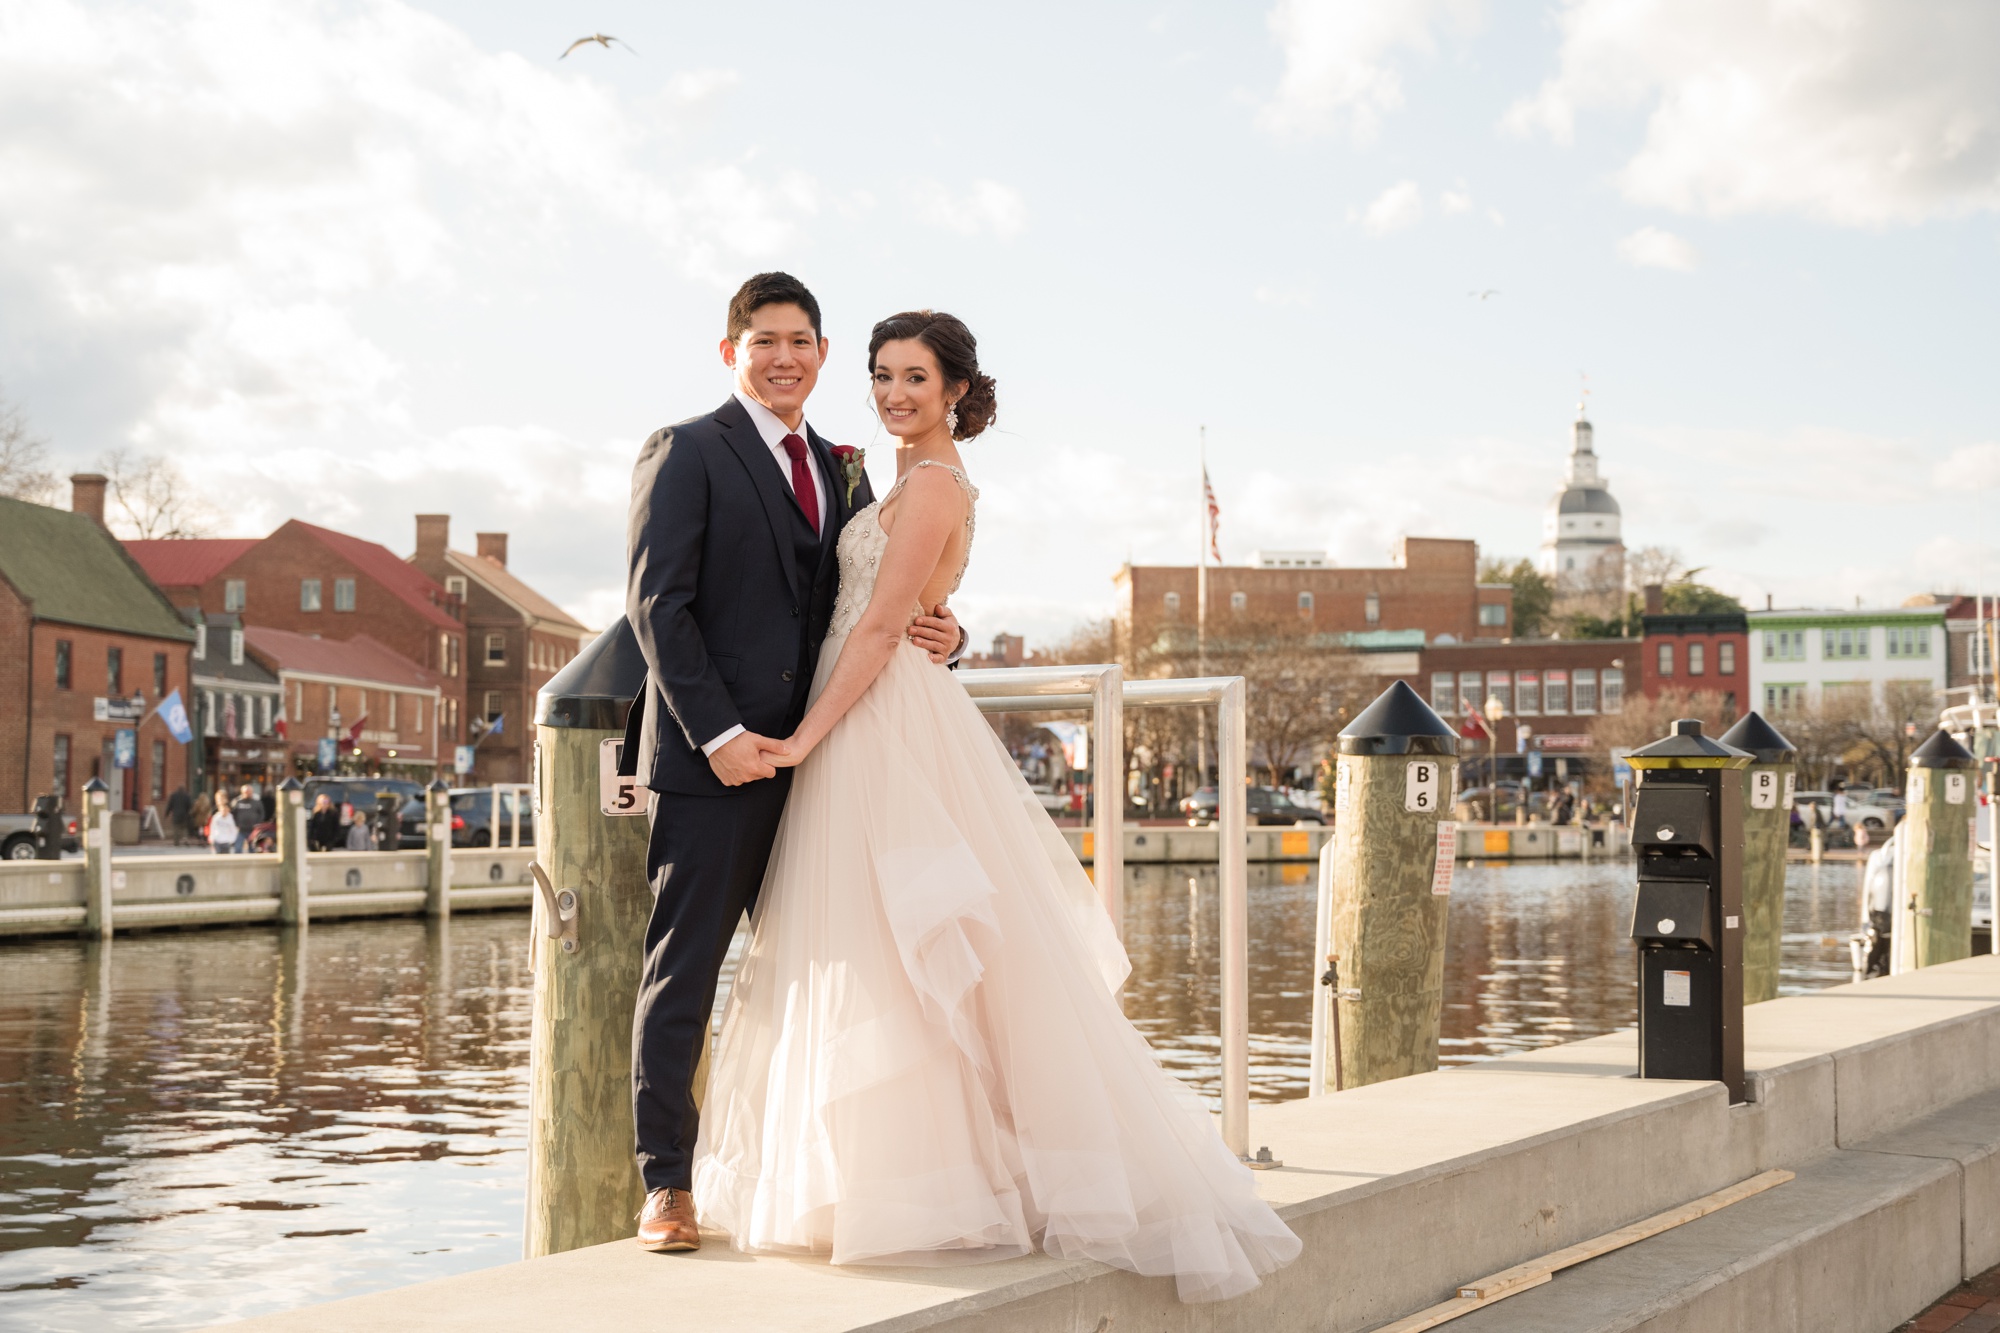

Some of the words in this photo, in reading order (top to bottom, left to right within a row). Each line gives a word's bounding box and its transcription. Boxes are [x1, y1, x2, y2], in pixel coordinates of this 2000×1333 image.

[1417, 766, 1429, 783] B
[1760, 775, 1770, 787] B
[617, 785, 636, 809] 5
[1417, 792, 1428, 807] 6
[1760, 794, 1768, 803] 7
